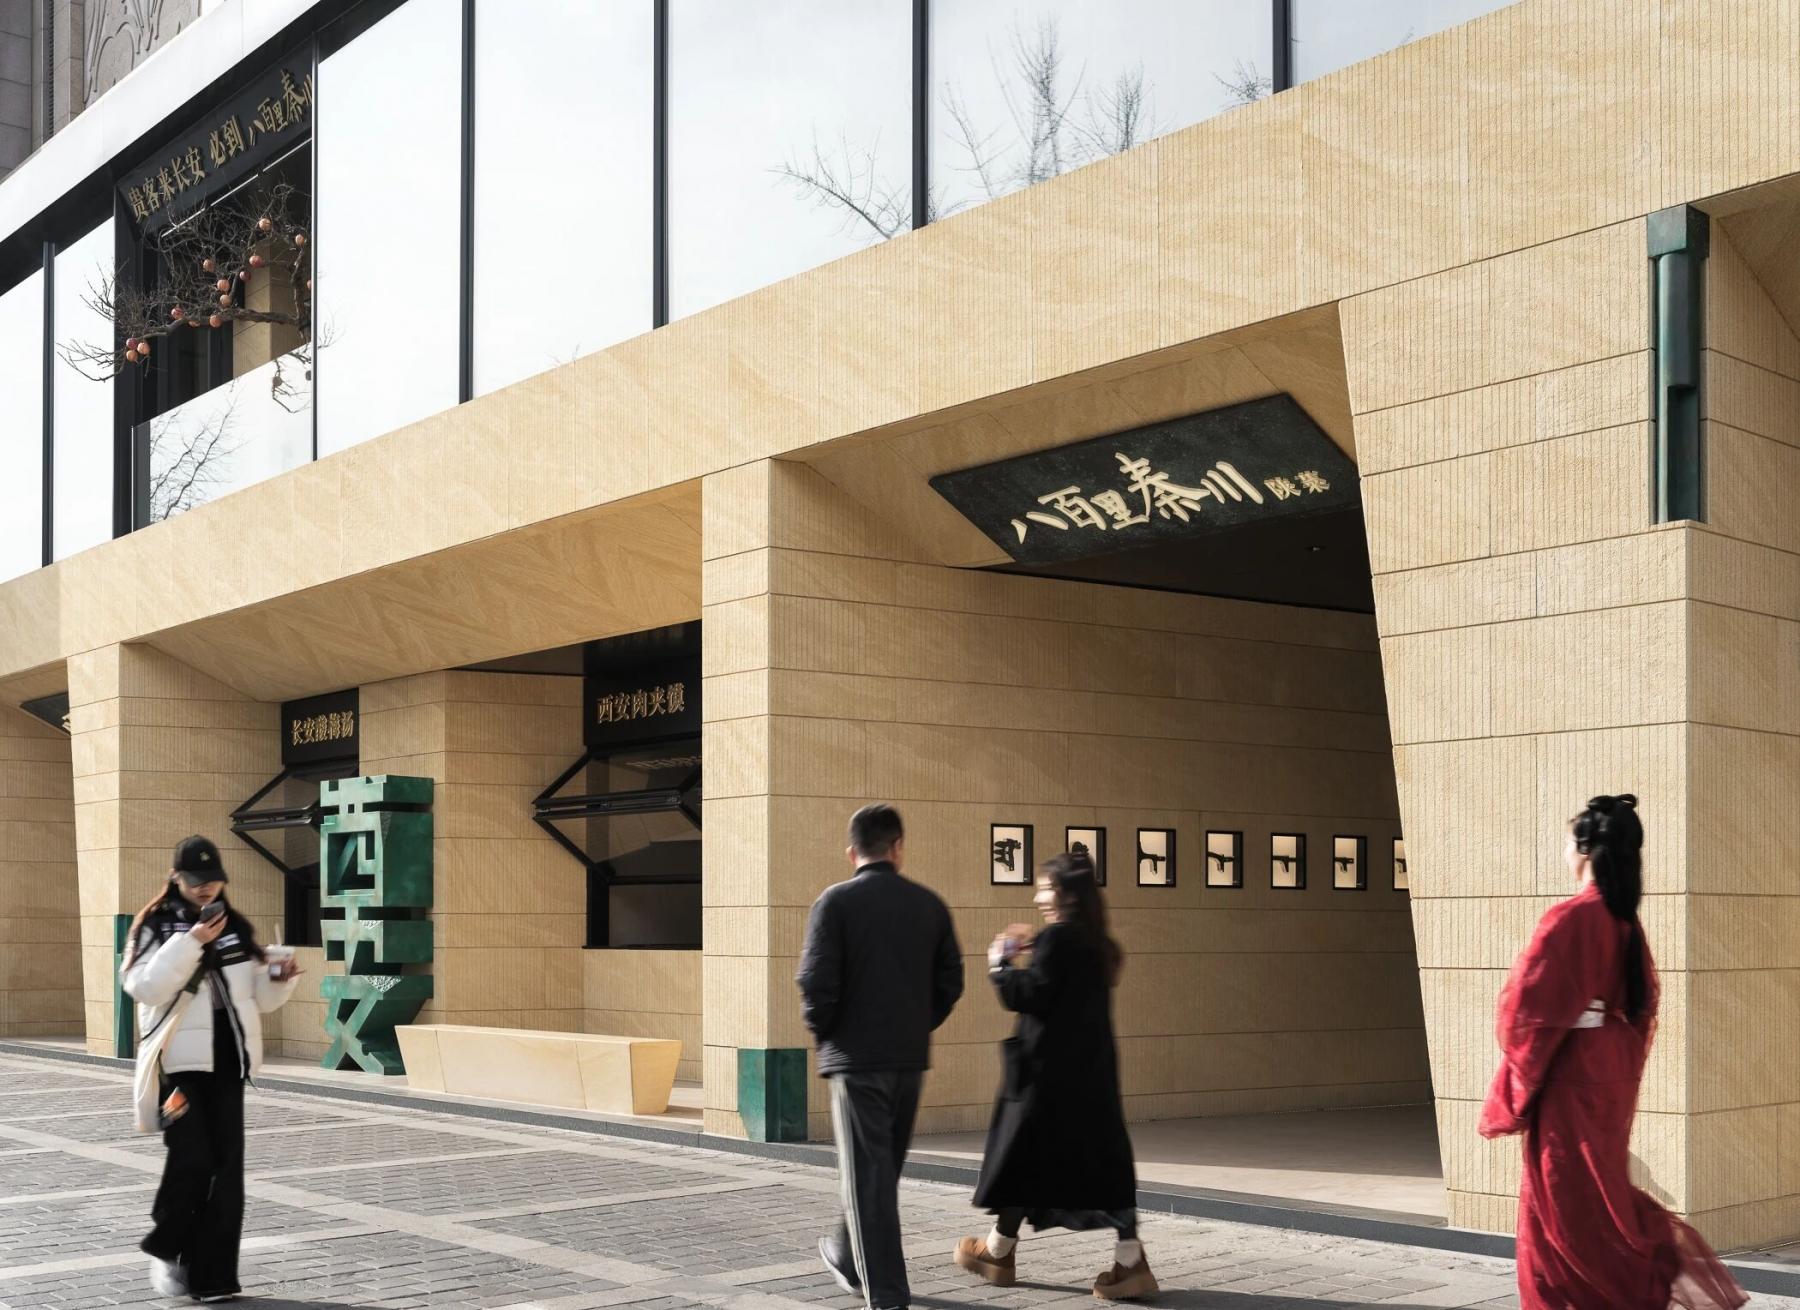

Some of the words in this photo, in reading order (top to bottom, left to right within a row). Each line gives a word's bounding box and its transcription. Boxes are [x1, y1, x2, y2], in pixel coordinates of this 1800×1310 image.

[127, 147, 206, 224] 贵客来长安
[209, 115, 245, 168] 必到
[1010, 451, 1264, 545] 八百里秦川
[1263, 470, 1331, 501] 陕菜
[597, 682, 685, 724] 西安肉夹馍
